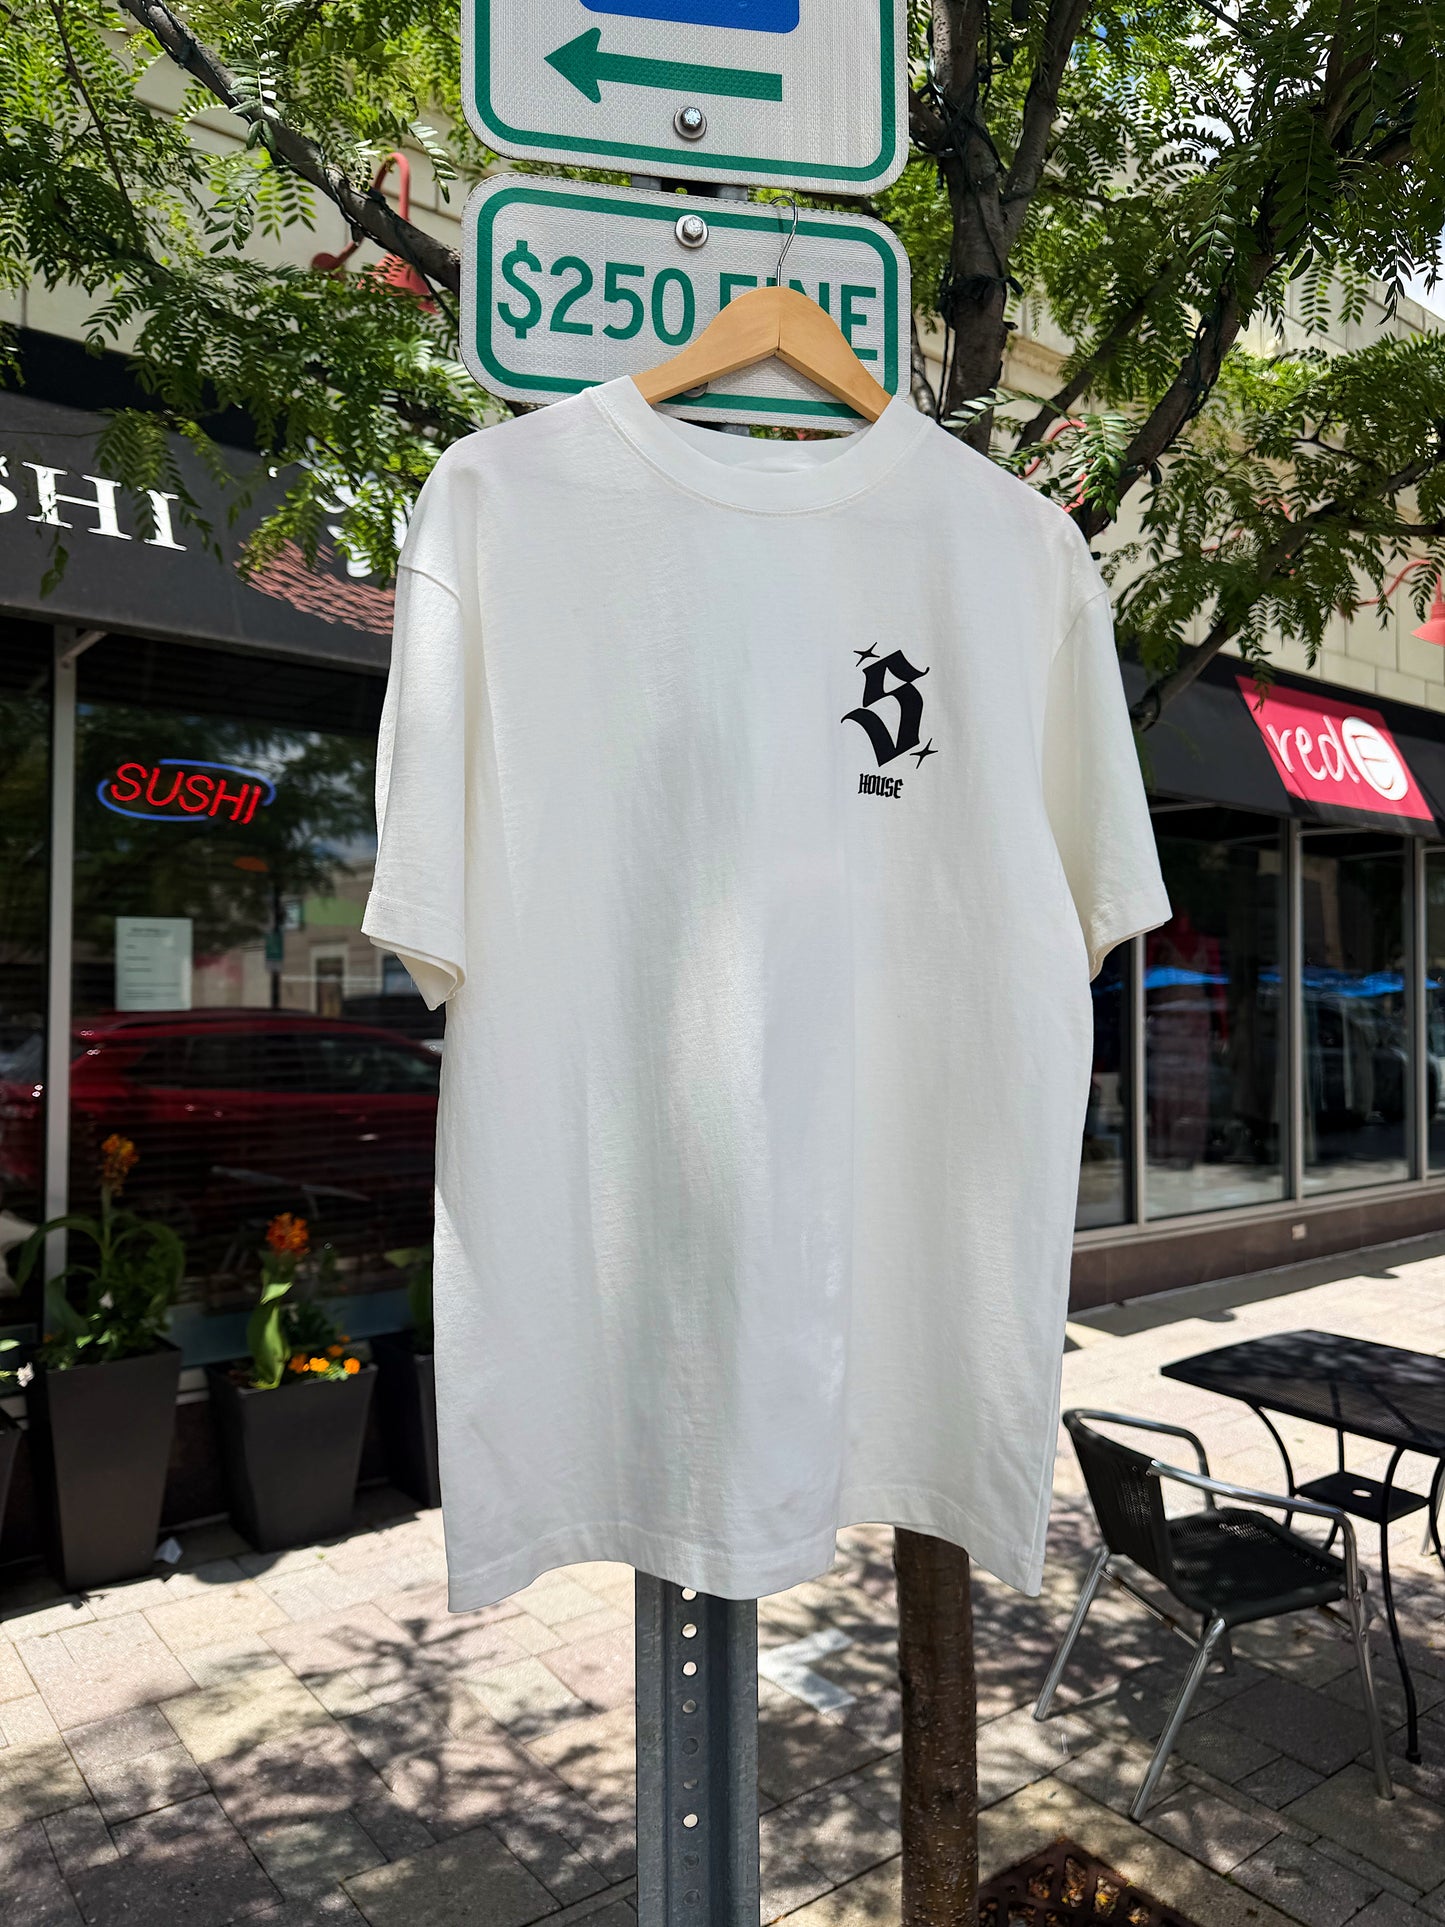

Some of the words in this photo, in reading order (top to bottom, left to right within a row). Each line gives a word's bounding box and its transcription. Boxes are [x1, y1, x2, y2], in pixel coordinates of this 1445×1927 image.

[497, 240, 696, 346] $250
[111, 762, 262, 825] SUSHI
[858, 773, 904, 799] HOUSE
